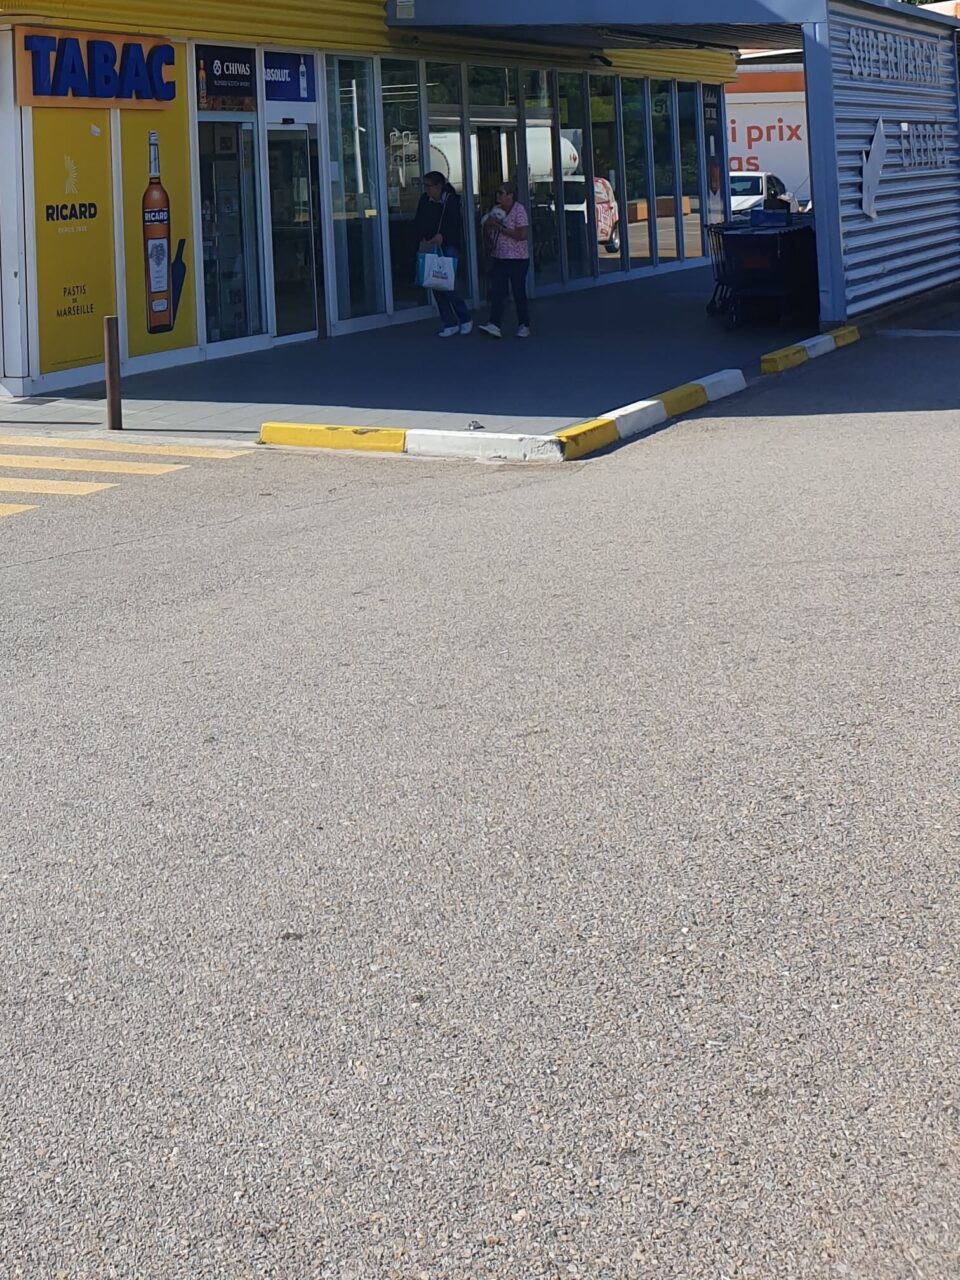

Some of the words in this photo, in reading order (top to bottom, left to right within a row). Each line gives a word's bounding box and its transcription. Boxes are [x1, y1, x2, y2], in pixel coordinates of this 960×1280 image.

[24, 34, 176, 102] TABAC
[223, 62, 250, 75] CHIVAS
[746, 117, 802, 150] prix
[46, 203, 97, 221] RICARD
[144, 211, 168, 220] RICARD
[63, 285, 86, 297] PASTIS
[56, 304, 94, 317] MARSEILLE
